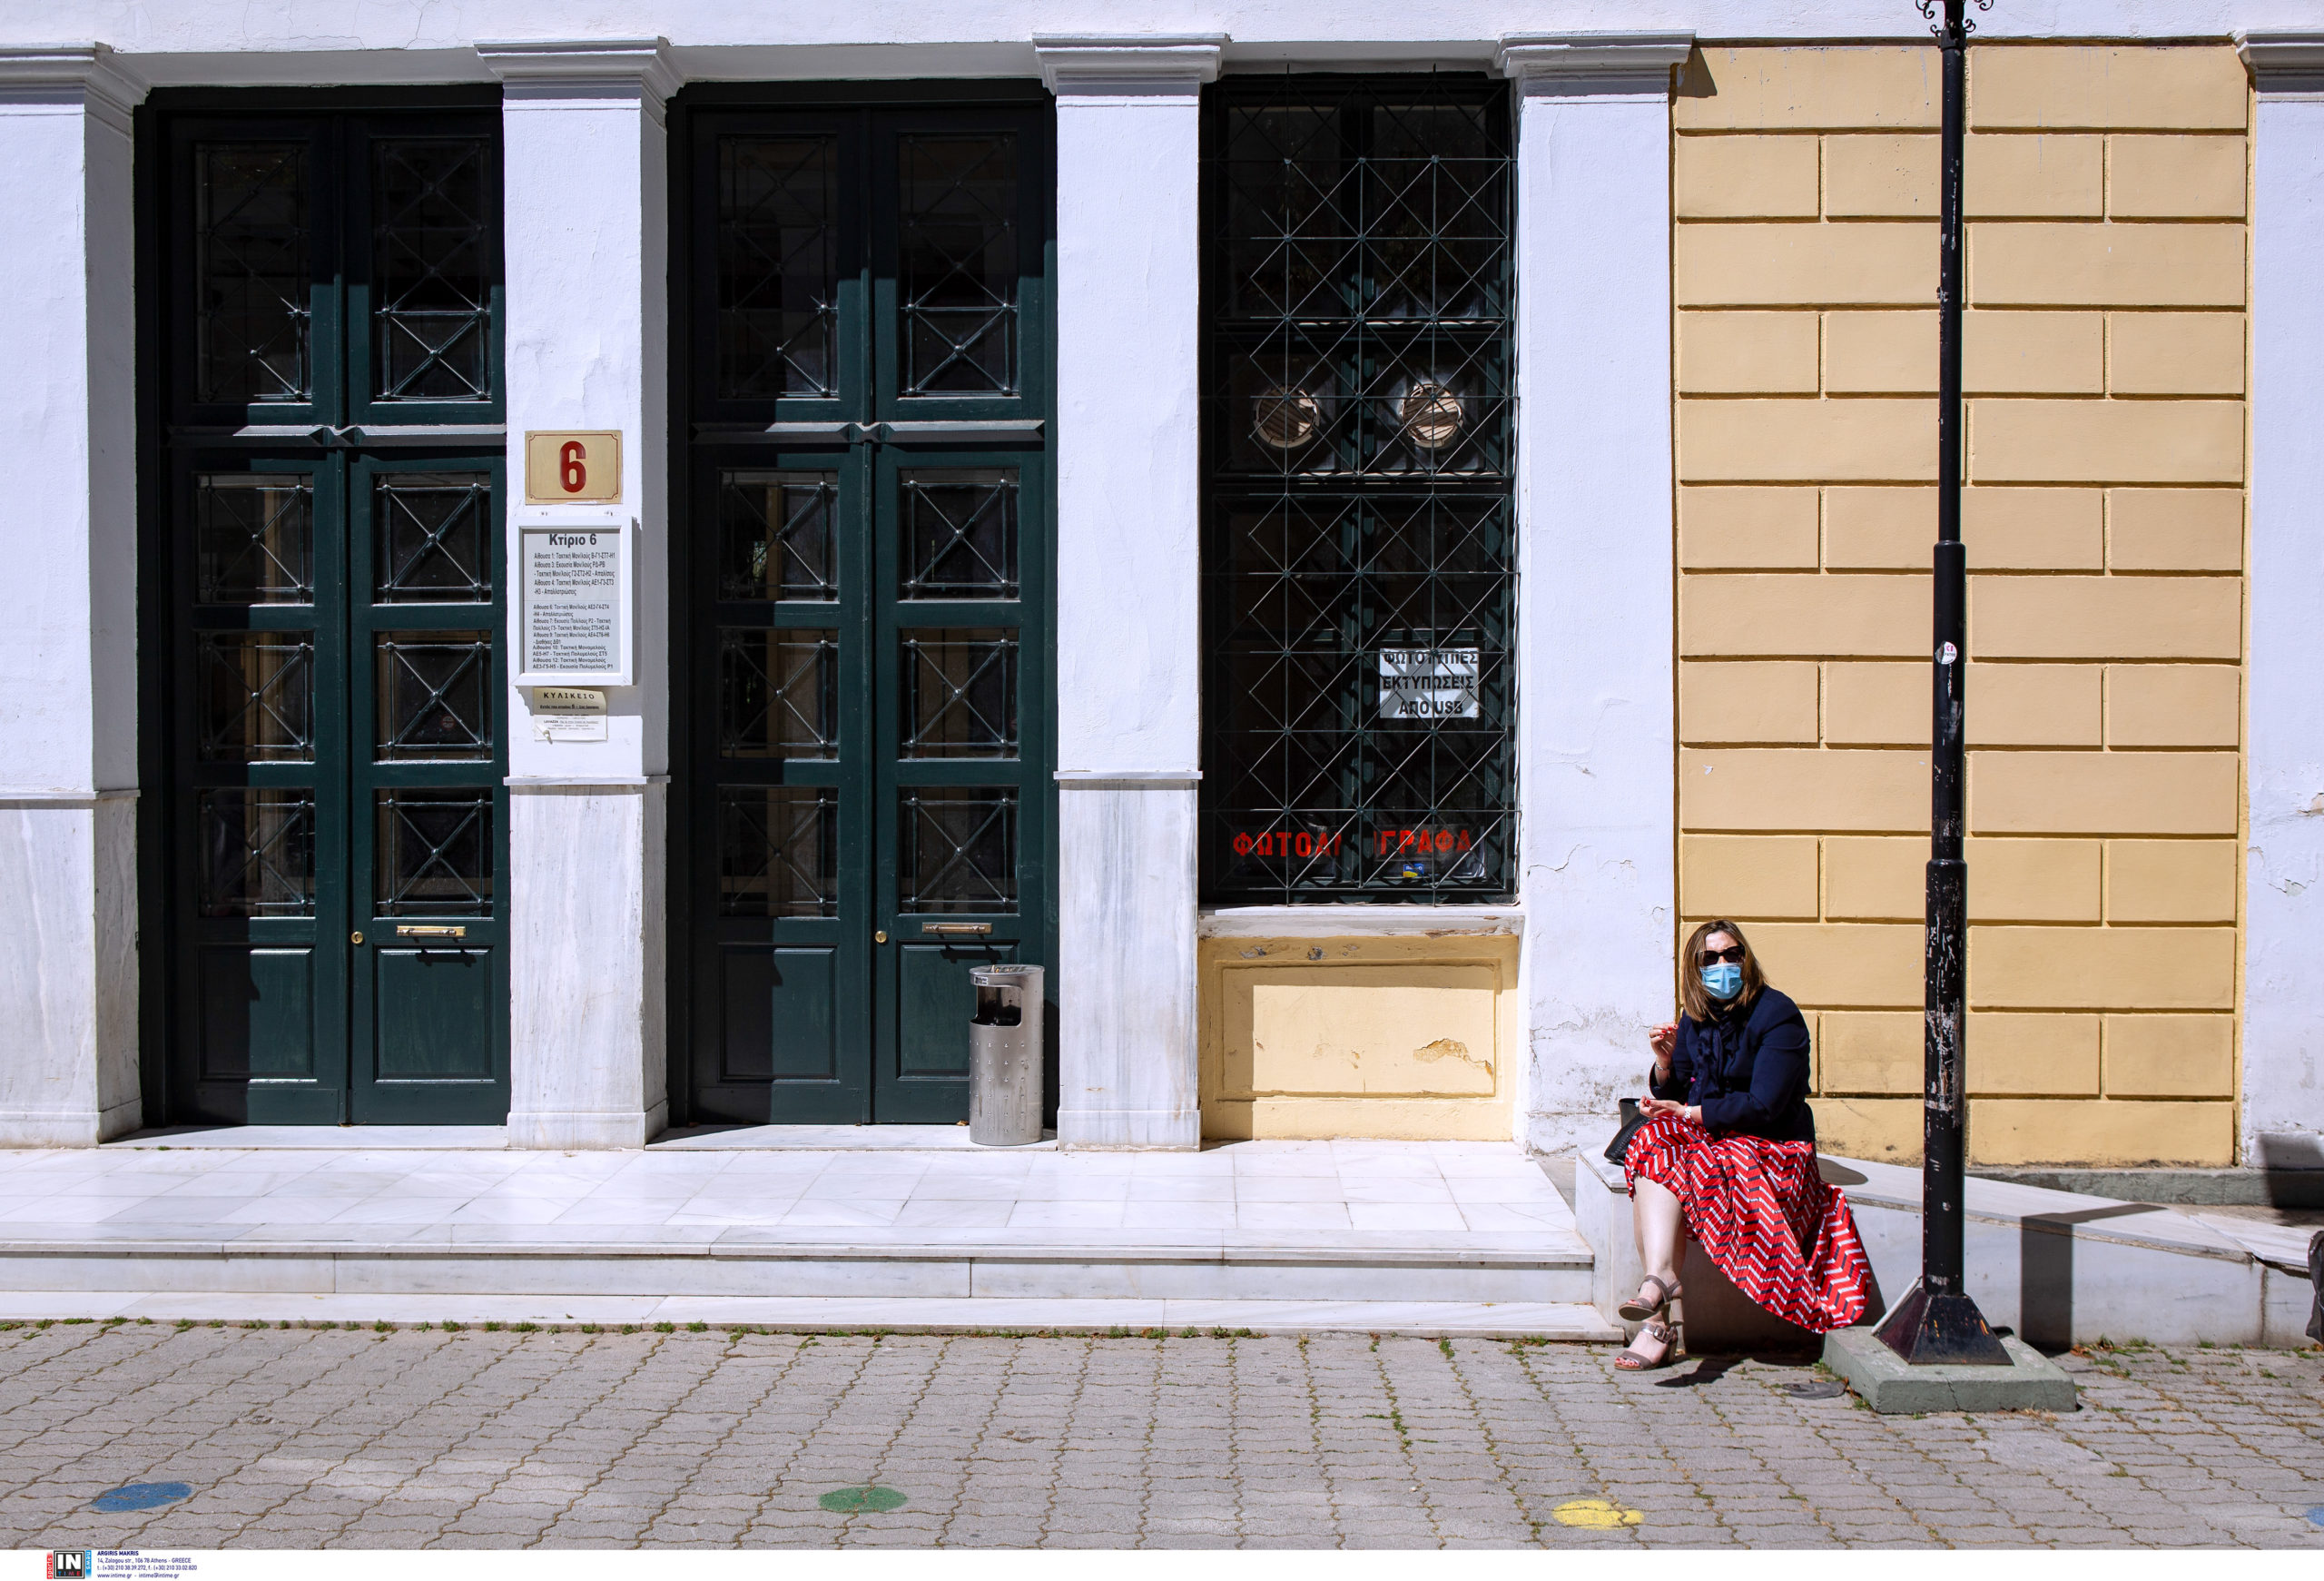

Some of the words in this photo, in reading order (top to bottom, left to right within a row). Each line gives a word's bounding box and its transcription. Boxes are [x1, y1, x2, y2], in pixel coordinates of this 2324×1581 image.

[559, 440, 586, 493] 6
[549, 533, 586, 548] Κτίριο
[589, 533, 597, 546] 6
[1383, 676, 1473, 689] ΕΚΤΥΠΩΣΕΙΣ
[1399, 701, 1430, 715] ΑΠΟ
[1435, 701, 1463, 715] USB
